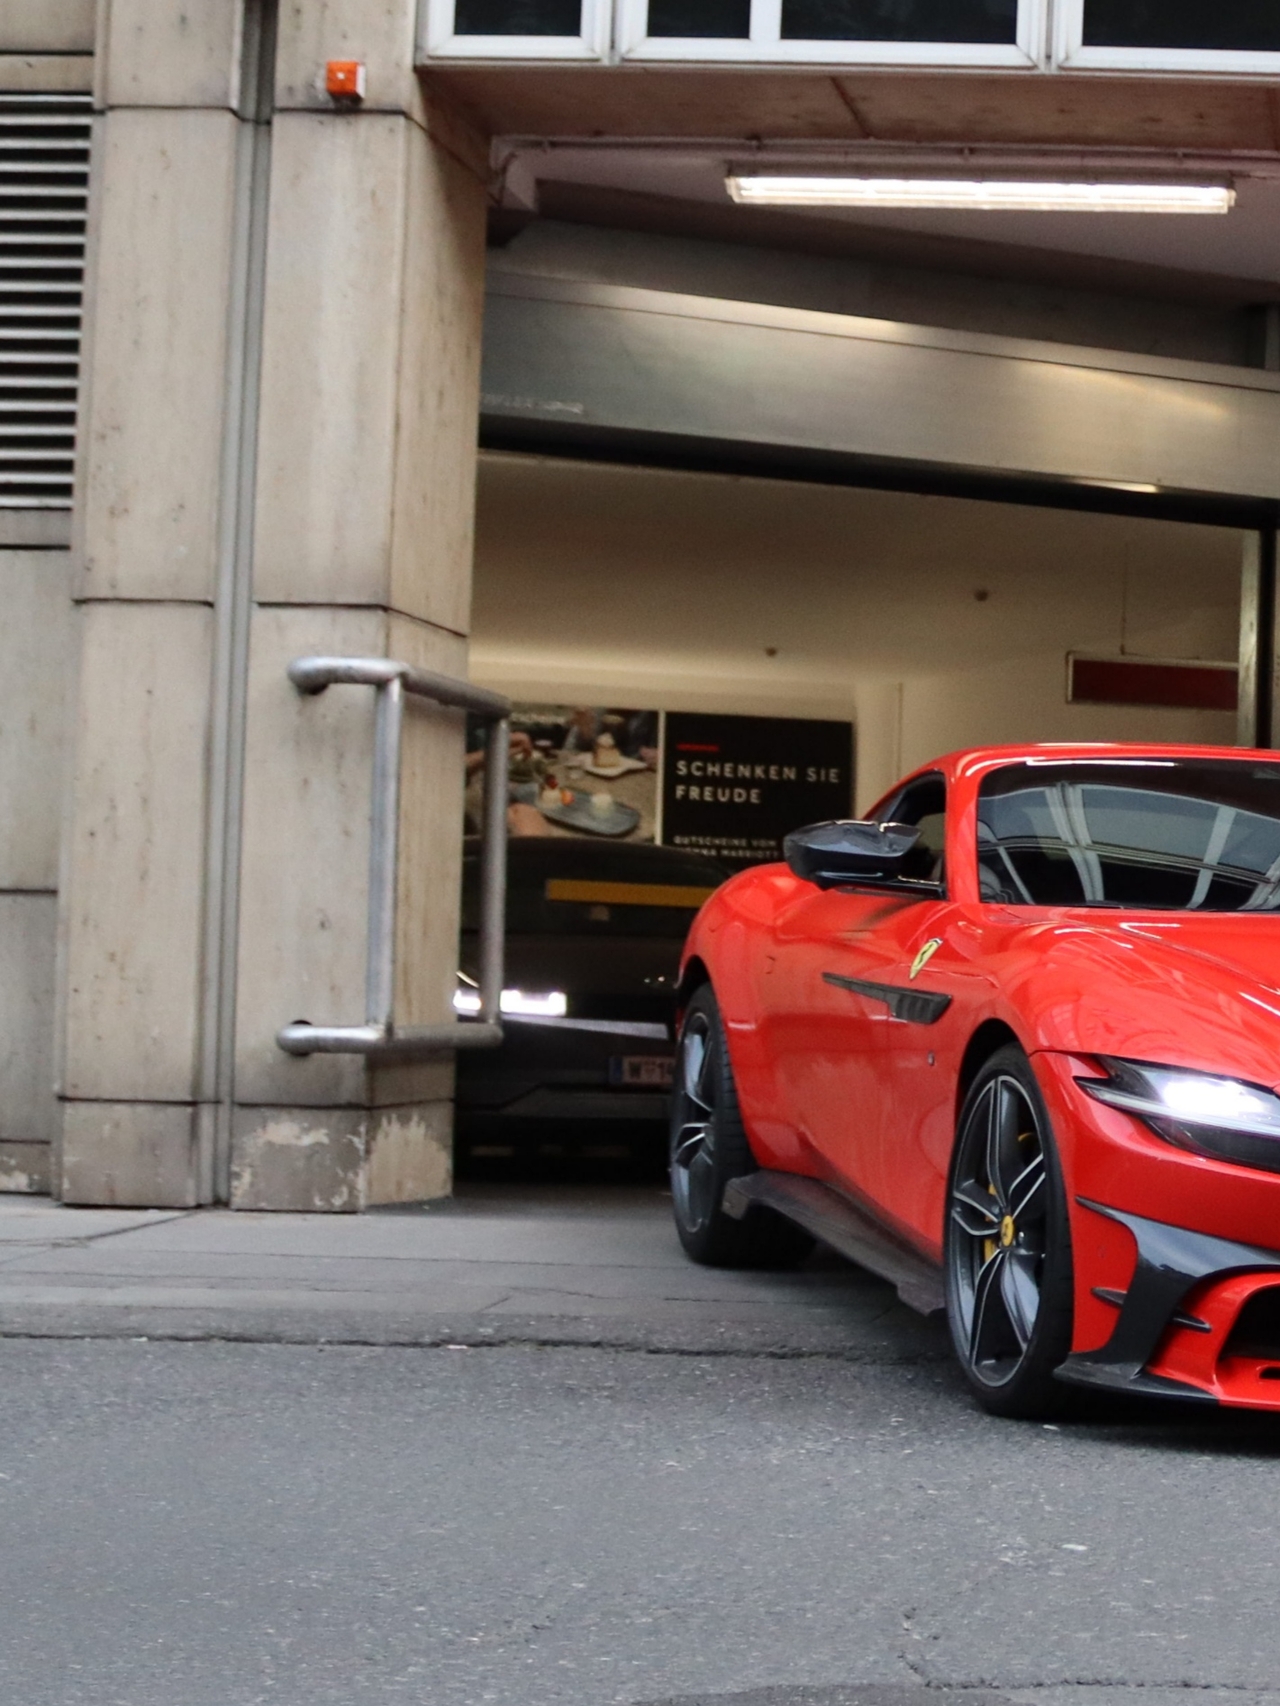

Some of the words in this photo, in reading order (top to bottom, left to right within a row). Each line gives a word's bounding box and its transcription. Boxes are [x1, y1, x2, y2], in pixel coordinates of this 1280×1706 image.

[675, 760, 797, 781] SCHENKEN
[806, 767, 840, 784] SIE
[675, 784, 762, 804] FREUDE
